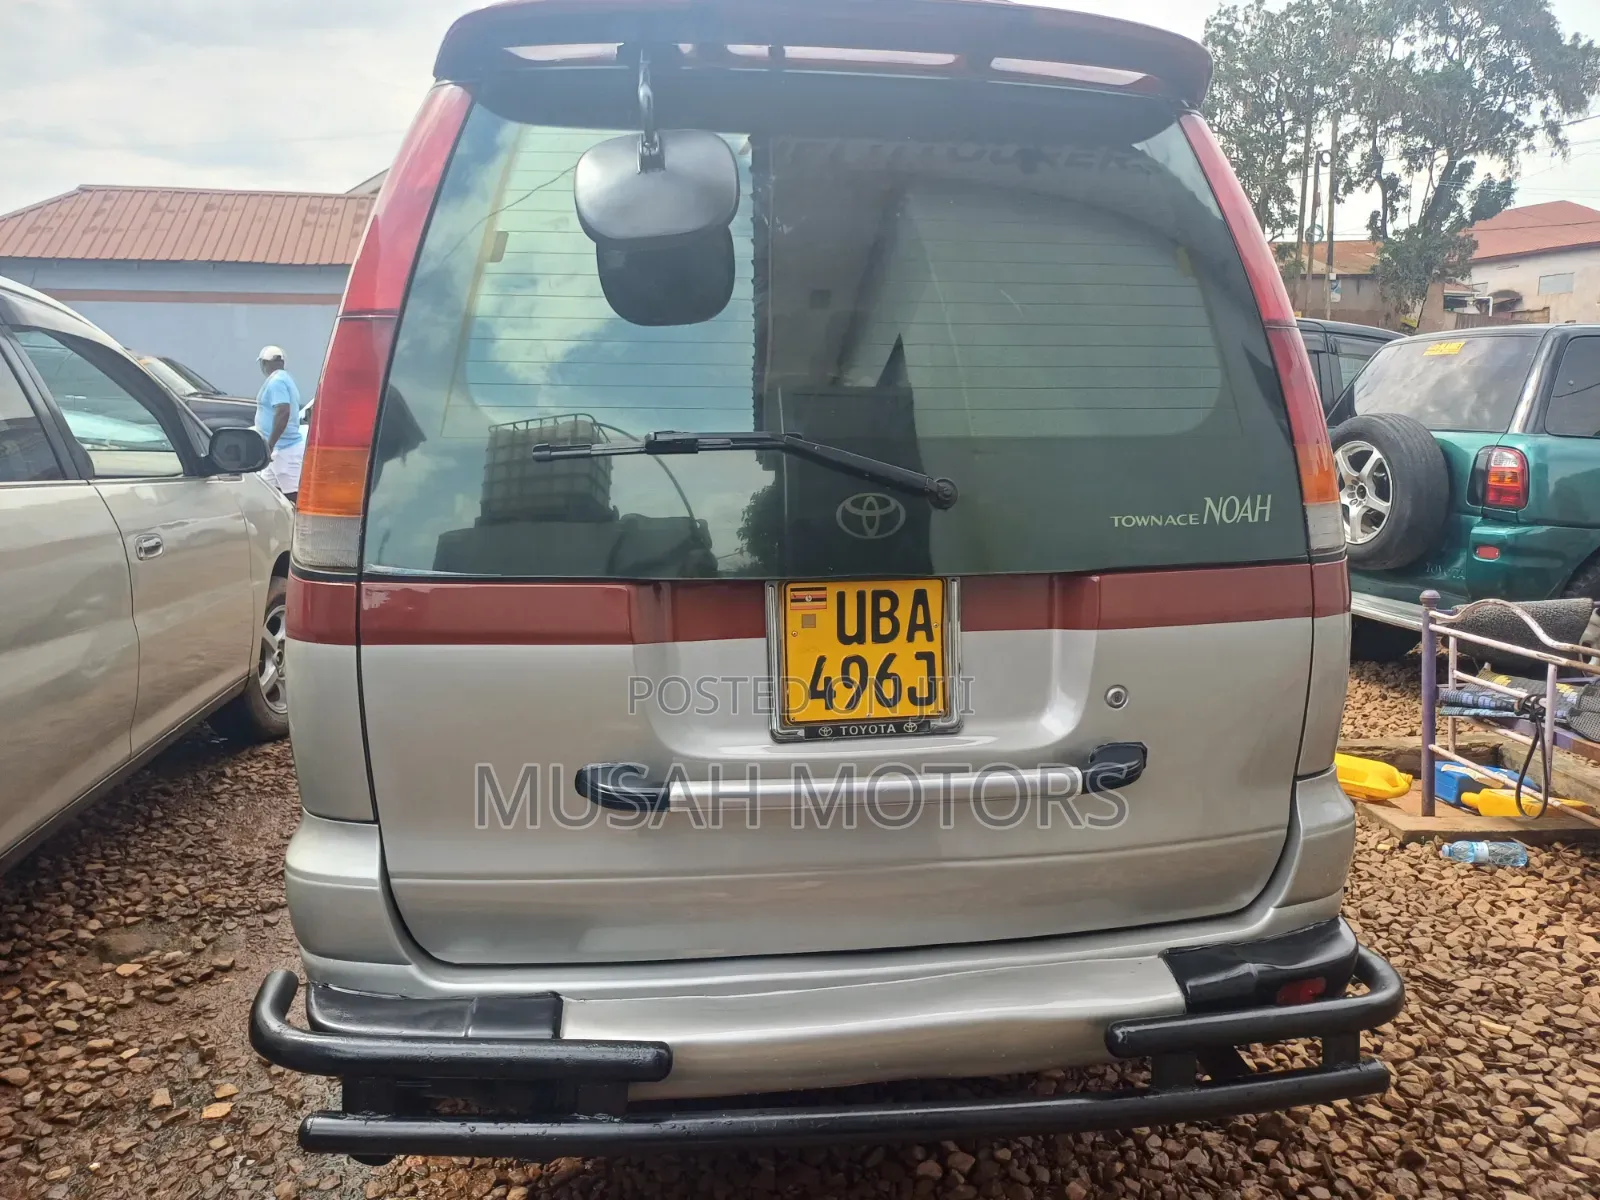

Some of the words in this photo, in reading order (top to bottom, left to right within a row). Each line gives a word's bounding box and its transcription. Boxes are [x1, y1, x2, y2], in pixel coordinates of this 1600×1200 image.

[1110, 513, 1200, 528] TOWNACE
[1203, 494, 1272, 525] NOAH
[836, 588, 935, 646] UBA
[808, 651, 938, 711] 496J
[839, 723, 897, 736] TOYOTA
